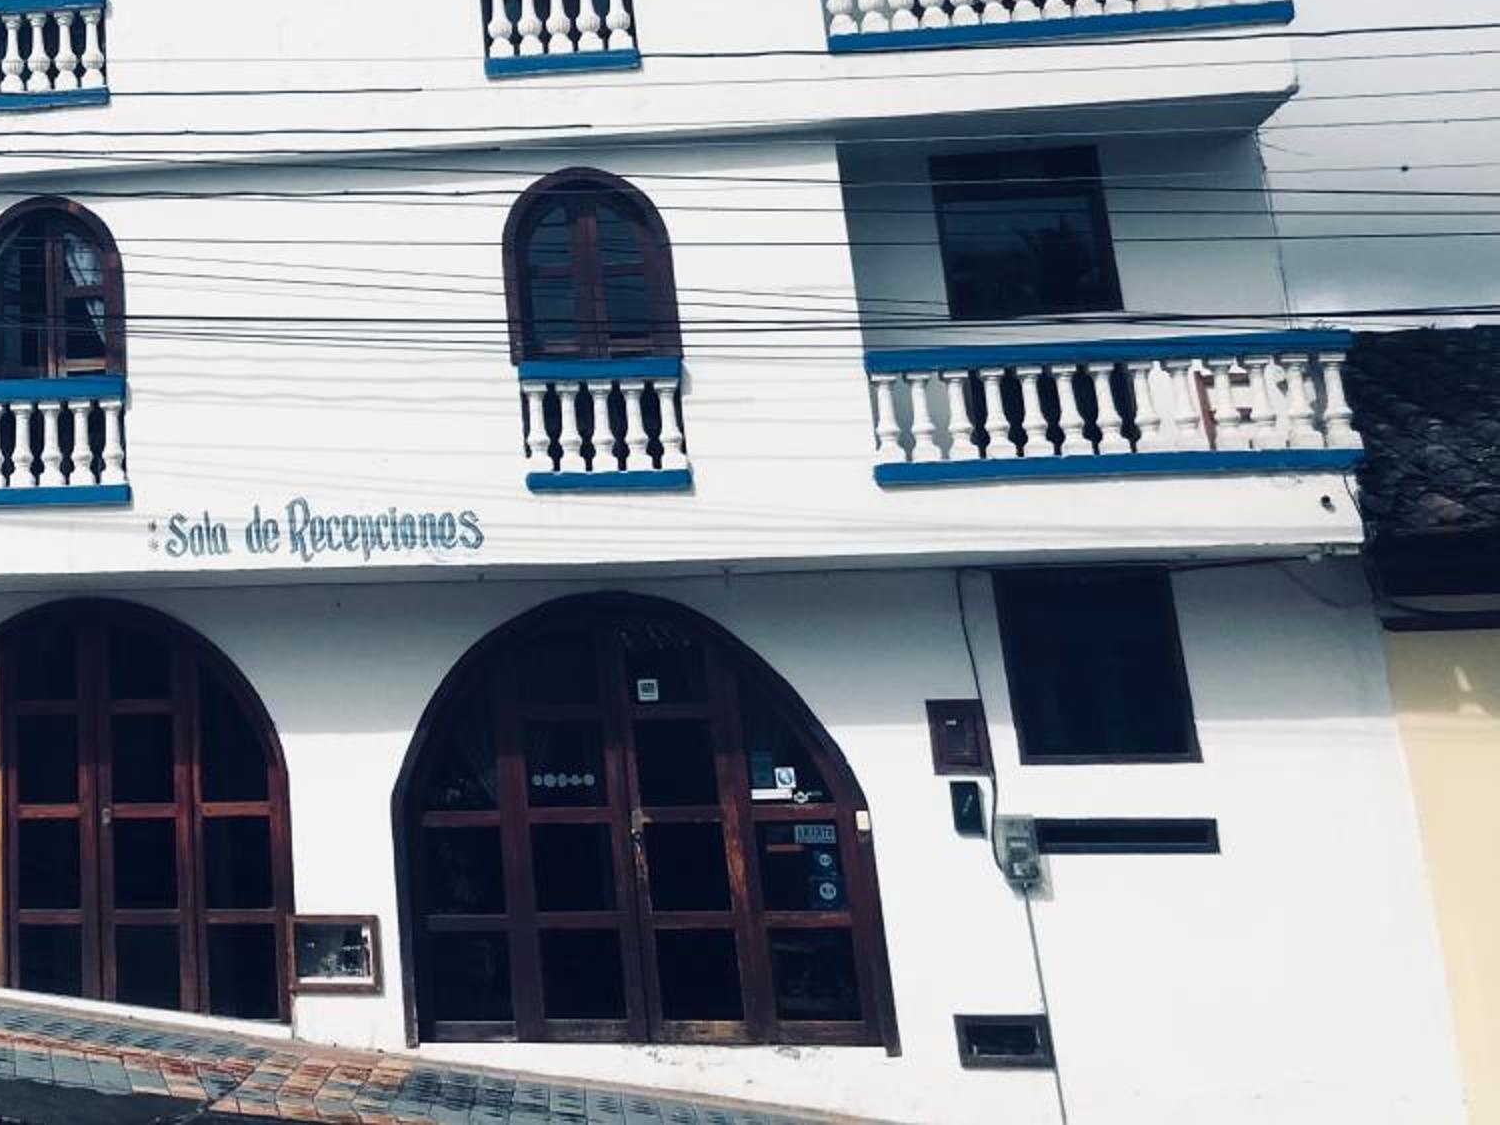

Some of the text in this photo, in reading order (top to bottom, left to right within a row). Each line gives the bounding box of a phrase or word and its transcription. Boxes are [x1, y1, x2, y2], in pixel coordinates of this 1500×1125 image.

[165, 496, 485, 563] Sala de Recepciones
